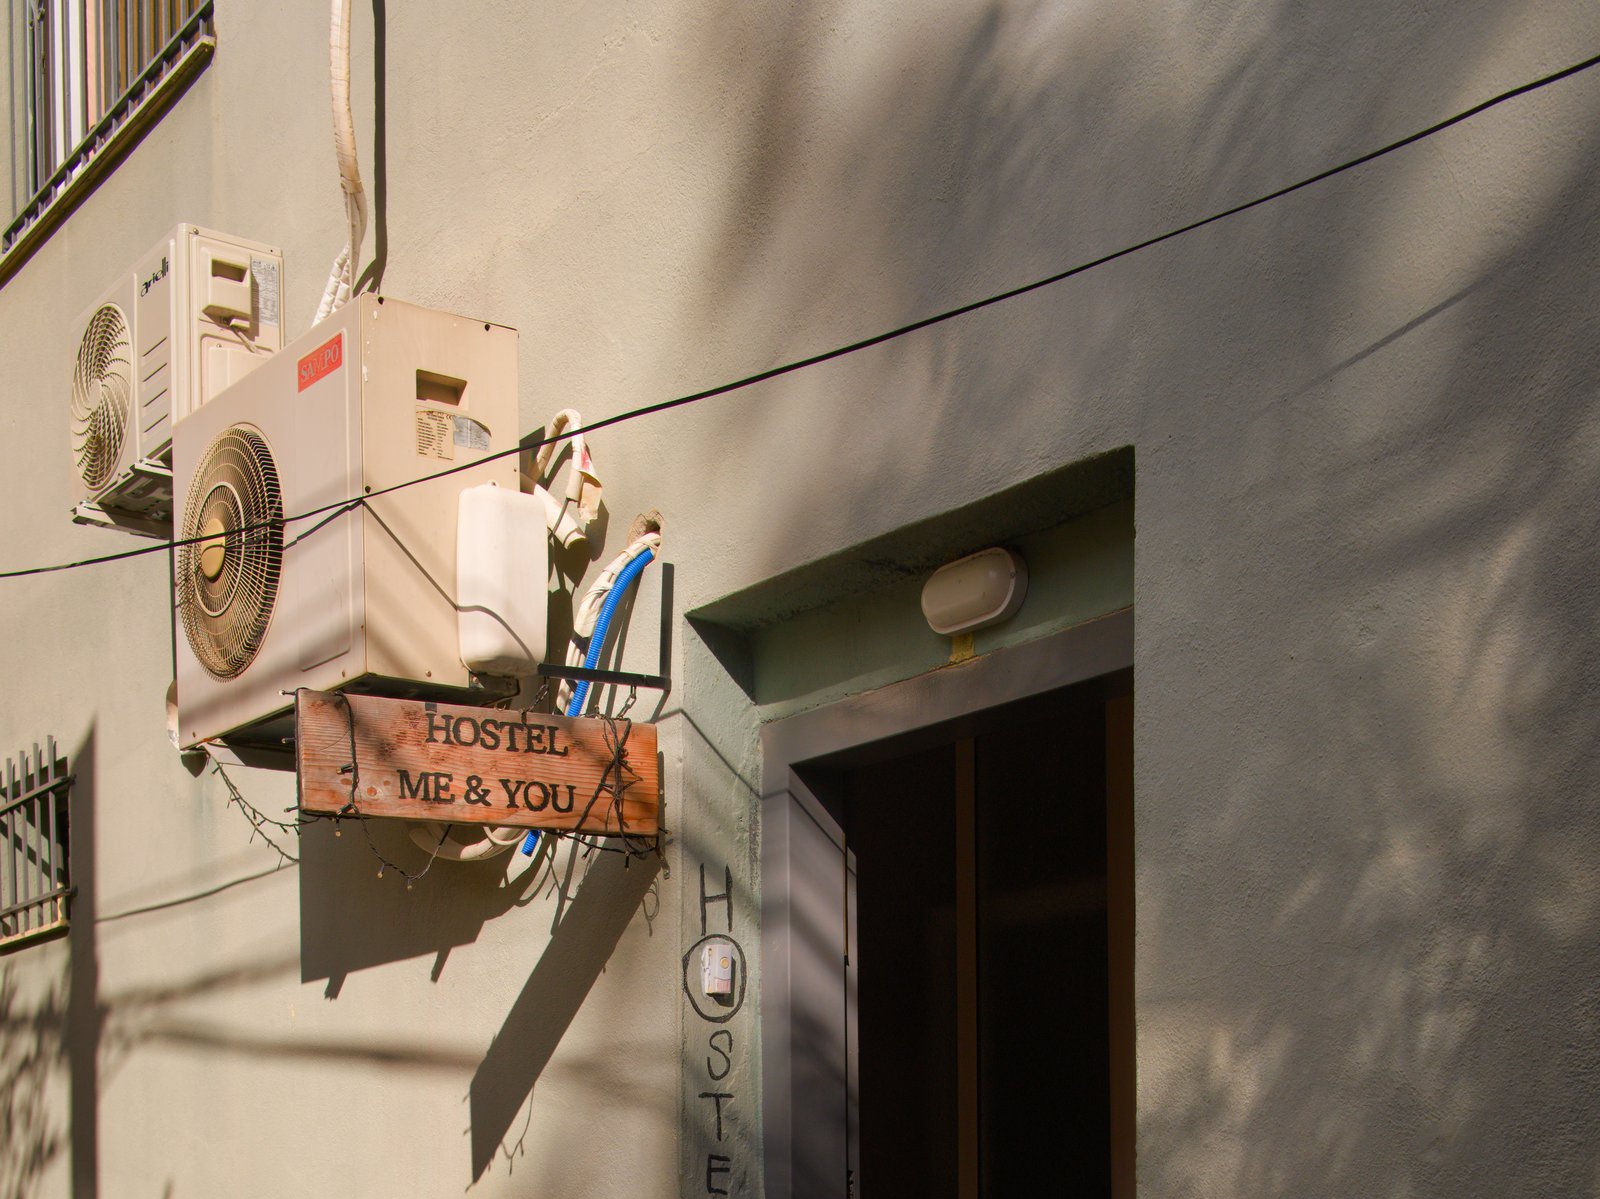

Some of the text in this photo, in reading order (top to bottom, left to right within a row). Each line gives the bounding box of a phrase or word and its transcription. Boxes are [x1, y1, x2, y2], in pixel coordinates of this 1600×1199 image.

[301, 344, 339, 383] SAMPO
[425, 712, 569, 757] HOSTEL
[397, 769, 577, 813] ME & YOU
